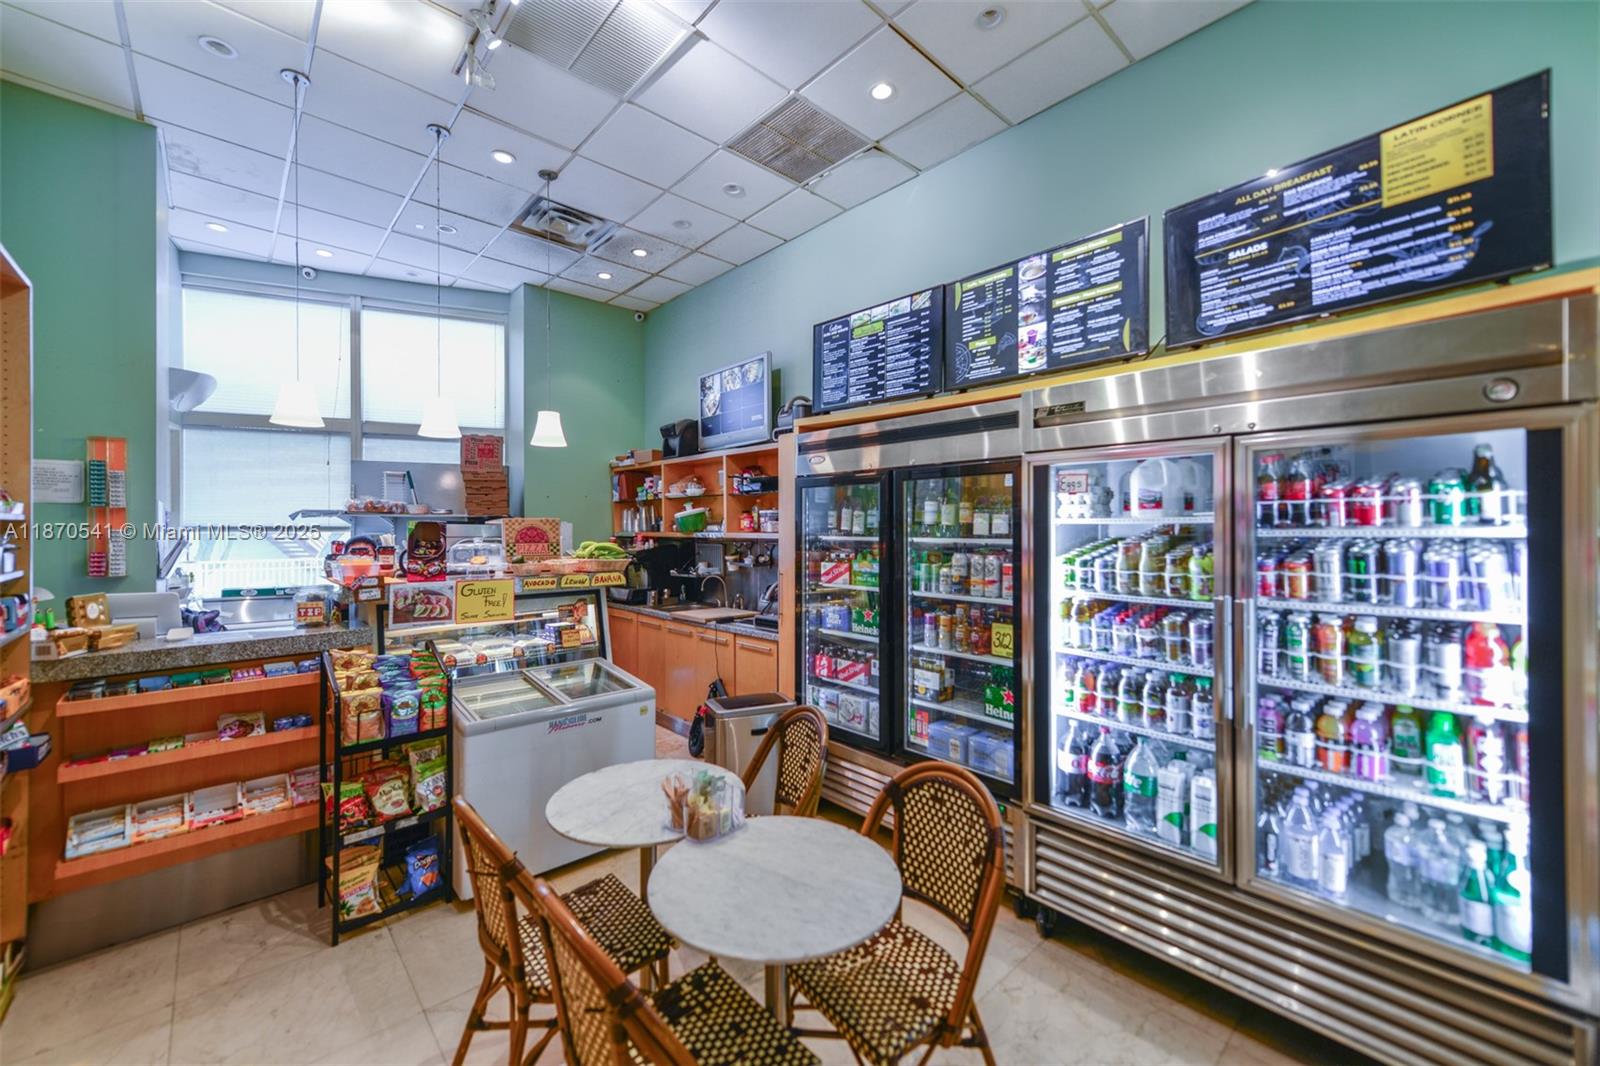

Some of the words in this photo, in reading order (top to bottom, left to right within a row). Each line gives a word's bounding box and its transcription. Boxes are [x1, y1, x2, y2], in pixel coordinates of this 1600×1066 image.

[1393, 124, 1428, 141] LATIN
[1429, 104, 1483, 128] CORNER
[1234, 191, 1254, 206] ALL
[1252, 186, 1273, 200] DAY
[1273, 164, 1334, 192] BREAKFAST
[1227, 241, 1269, 260] SALADS
[1059, 476, 1083, 492] Eggs
[524, 579, 557, 589] AVOCADO
[593, 575, 623, 586] BANANA
[460, 583, 497, 598] GLUTEN
[298, 607, 321, 617] TIP
